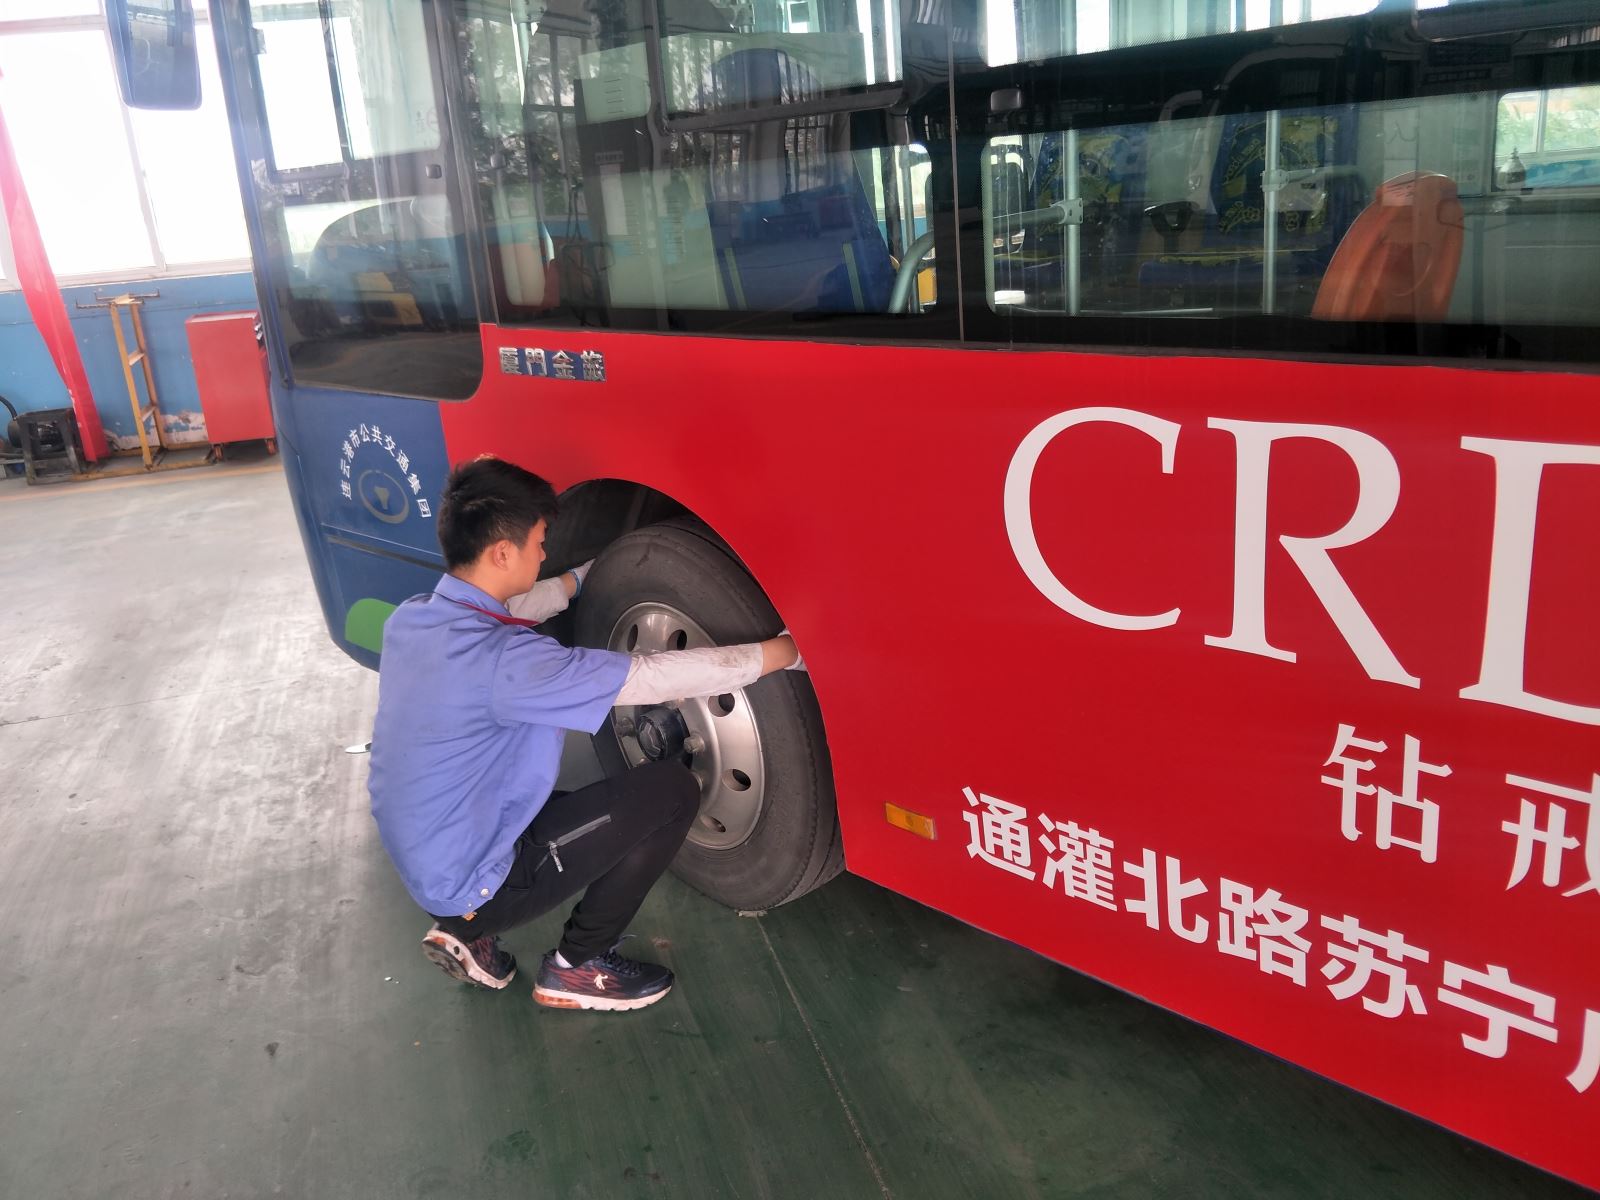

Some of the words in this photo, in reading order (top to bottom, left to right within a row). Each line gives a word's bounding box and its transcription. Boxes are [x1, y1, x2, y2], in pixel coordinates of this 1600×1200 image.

[962, 786, 1600, 1094] 通灌北路苏宁
